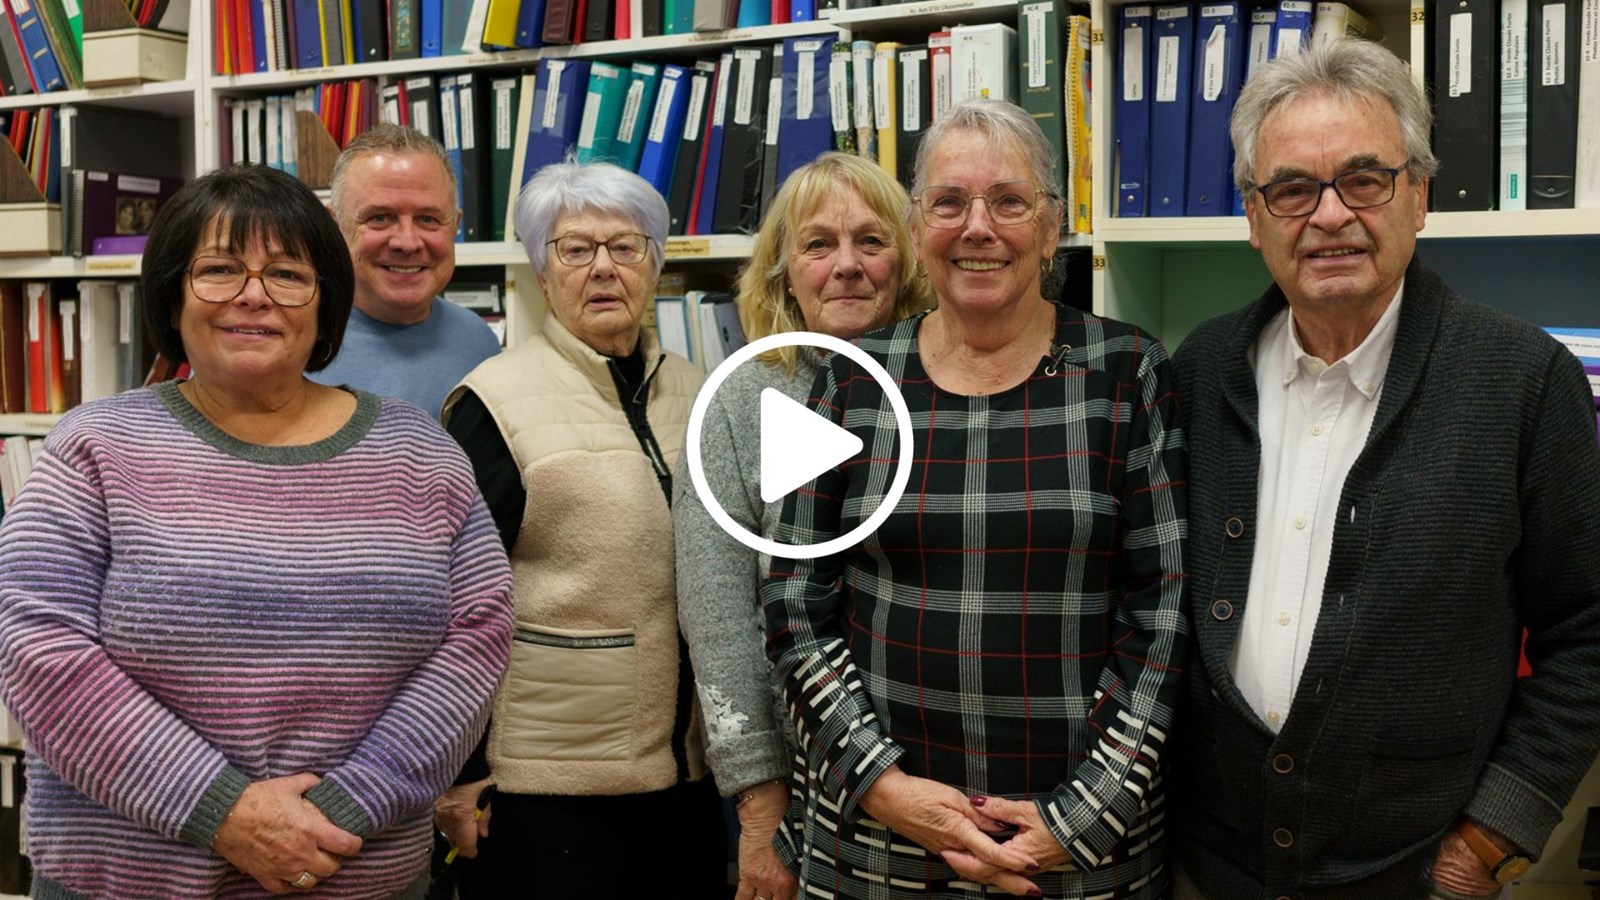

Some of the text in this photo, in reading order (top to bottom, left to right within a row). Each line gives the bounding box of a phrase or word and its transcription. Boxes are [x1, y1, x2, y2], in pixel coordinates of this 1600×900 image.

[1412, 11, 1425, 21] 32
[1093, 32, 1104, 42] 31
[1093, 258, 1105, 267] 33
